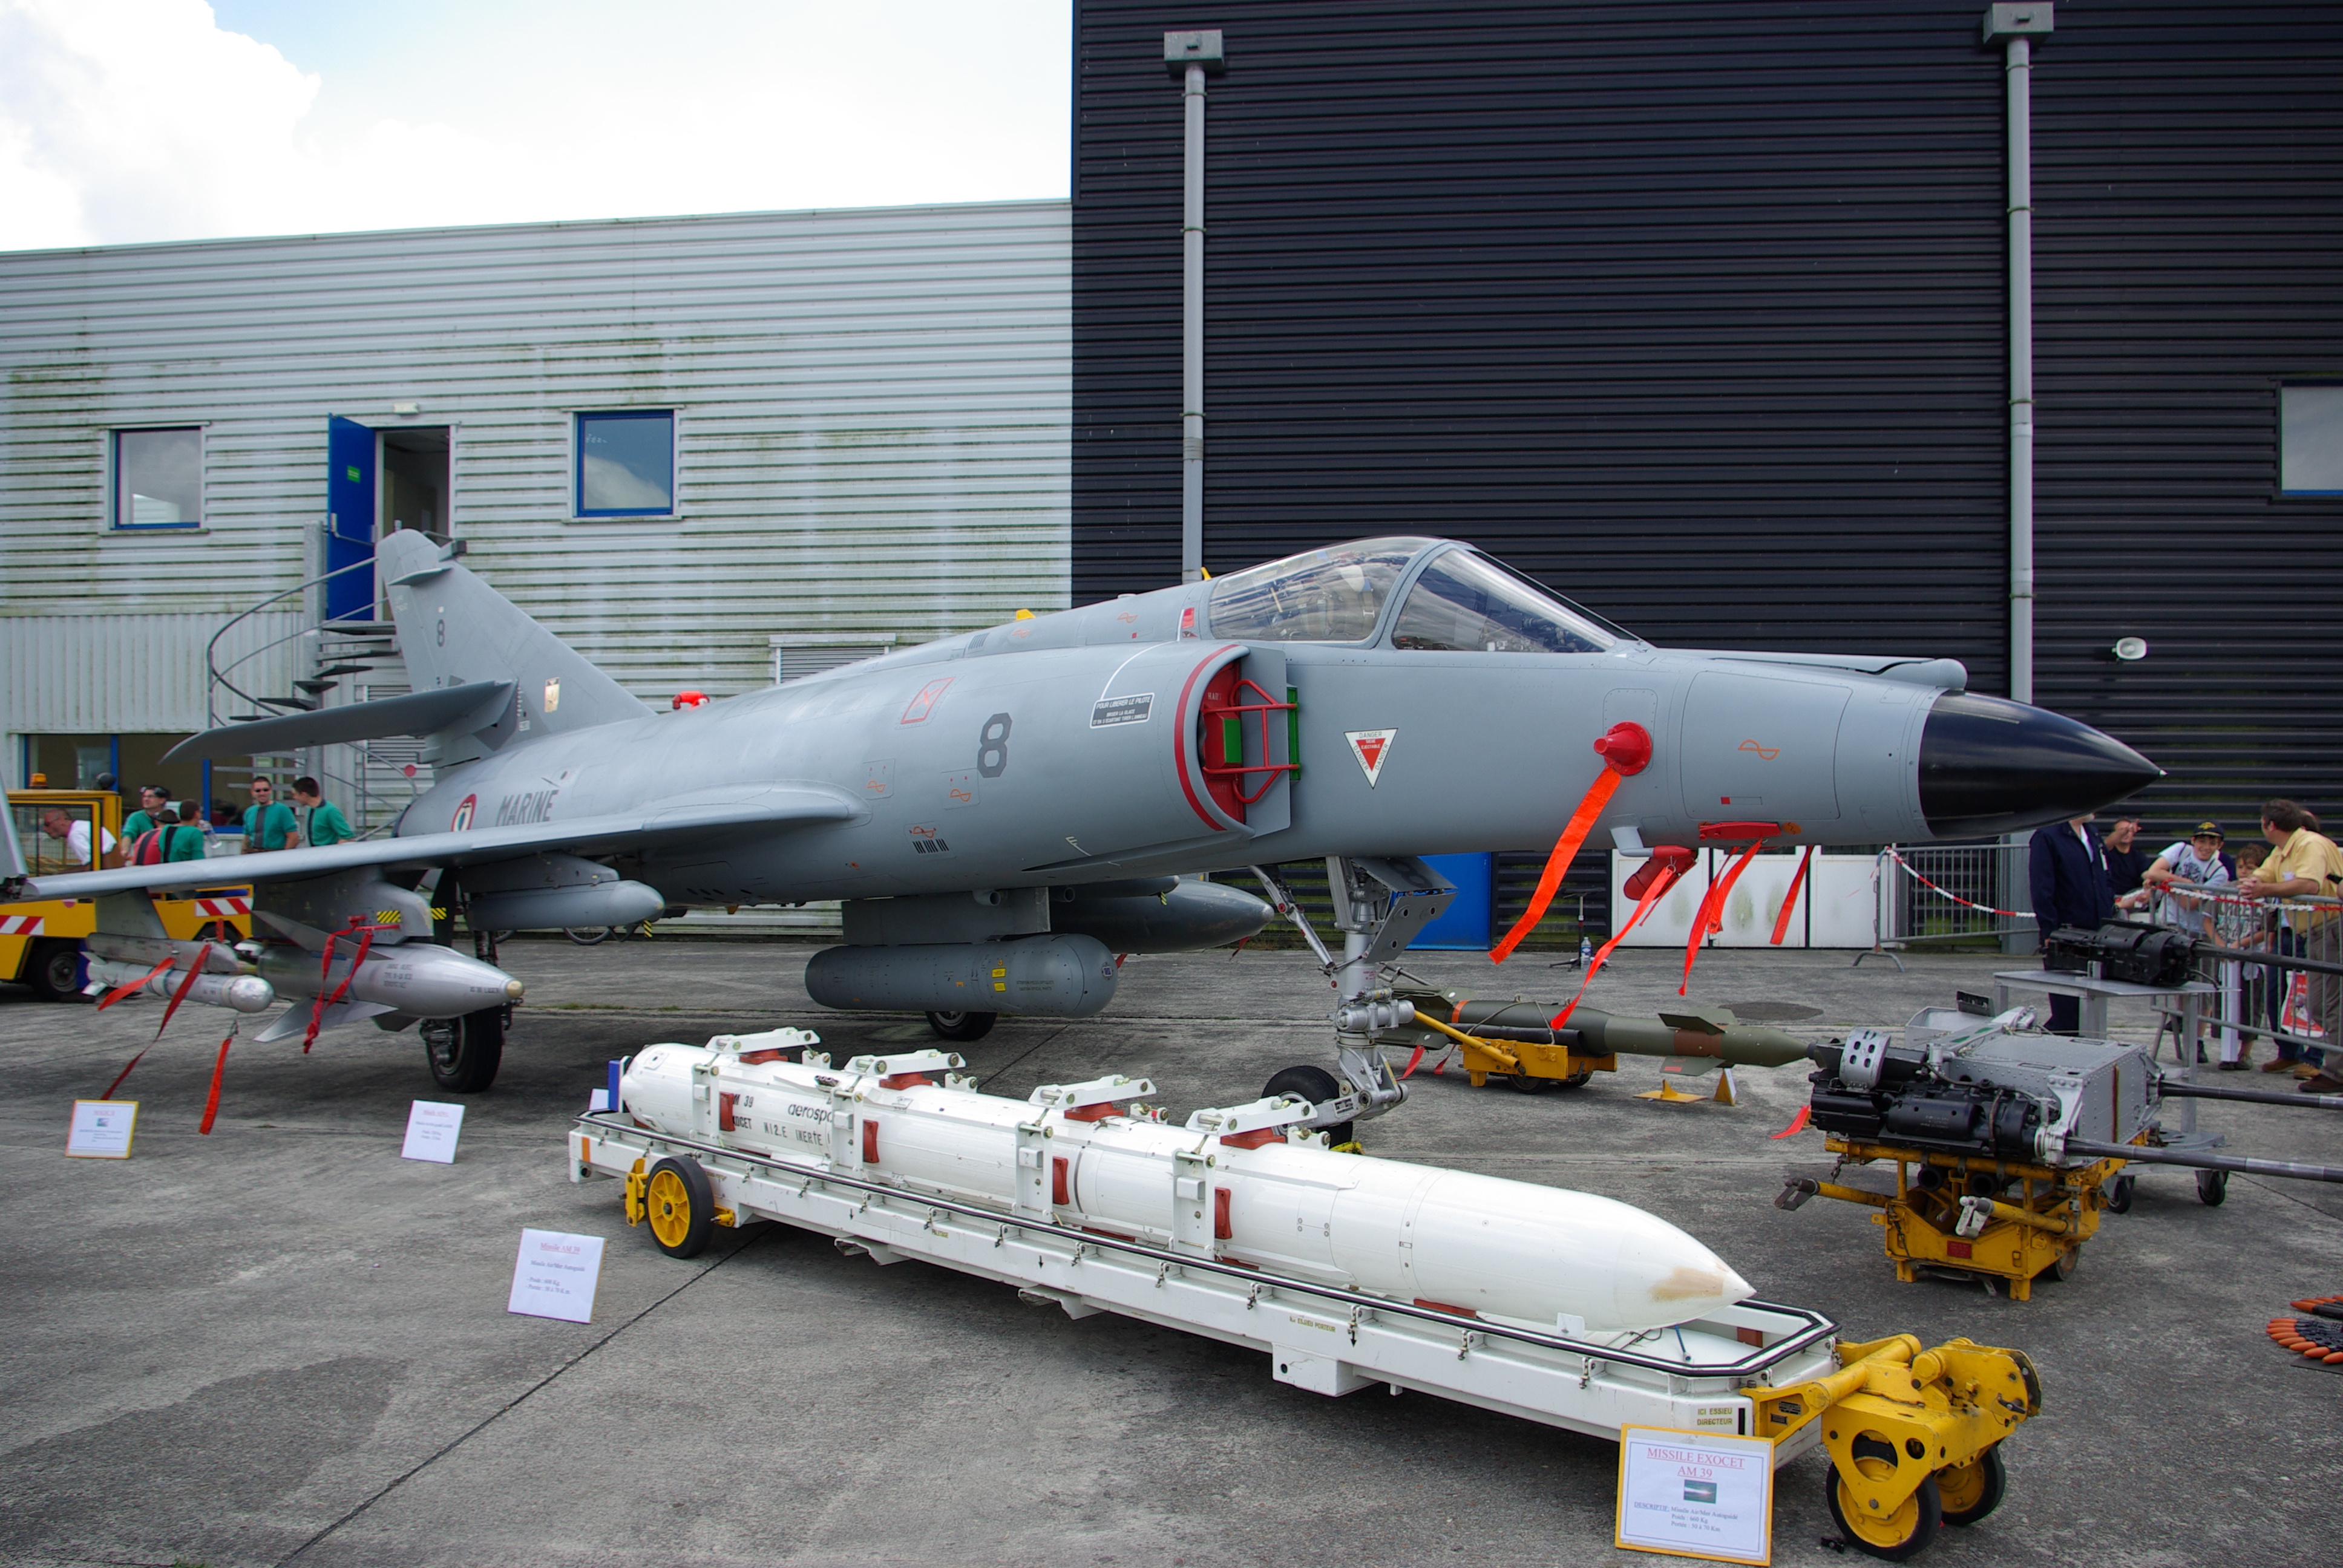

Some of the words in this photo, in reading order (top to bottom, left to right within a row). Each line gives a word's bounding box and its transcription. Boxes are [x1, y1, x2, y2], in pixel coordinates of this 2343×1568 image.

[437, 618, 445, 647] 8
[1109, 699, 1128, 708] LIBERER
[1135, 696, 1151, 704] PILOTE
[977, 712, 1013, 779] 8
[1353, 745, 1369, 771] DANGER
[1375, 743, 1389, 770] DANGER
[496, 789, 560, 827] MARINE
[733, 1094, 741, 1105] M
[744, 1096, 755, 1108] 39
[796, 1129, 823, 1146] INERTE
[1315, 1322, 1335, 1333] PORTEUR
[1647, 1448, 1694, 1462] MISSILE
[1697, 1454, 1745, 1468] EXOCET
[1677, 1466, 1697, 1477] AM
[1700, 1468, 1712, 1478] 39
